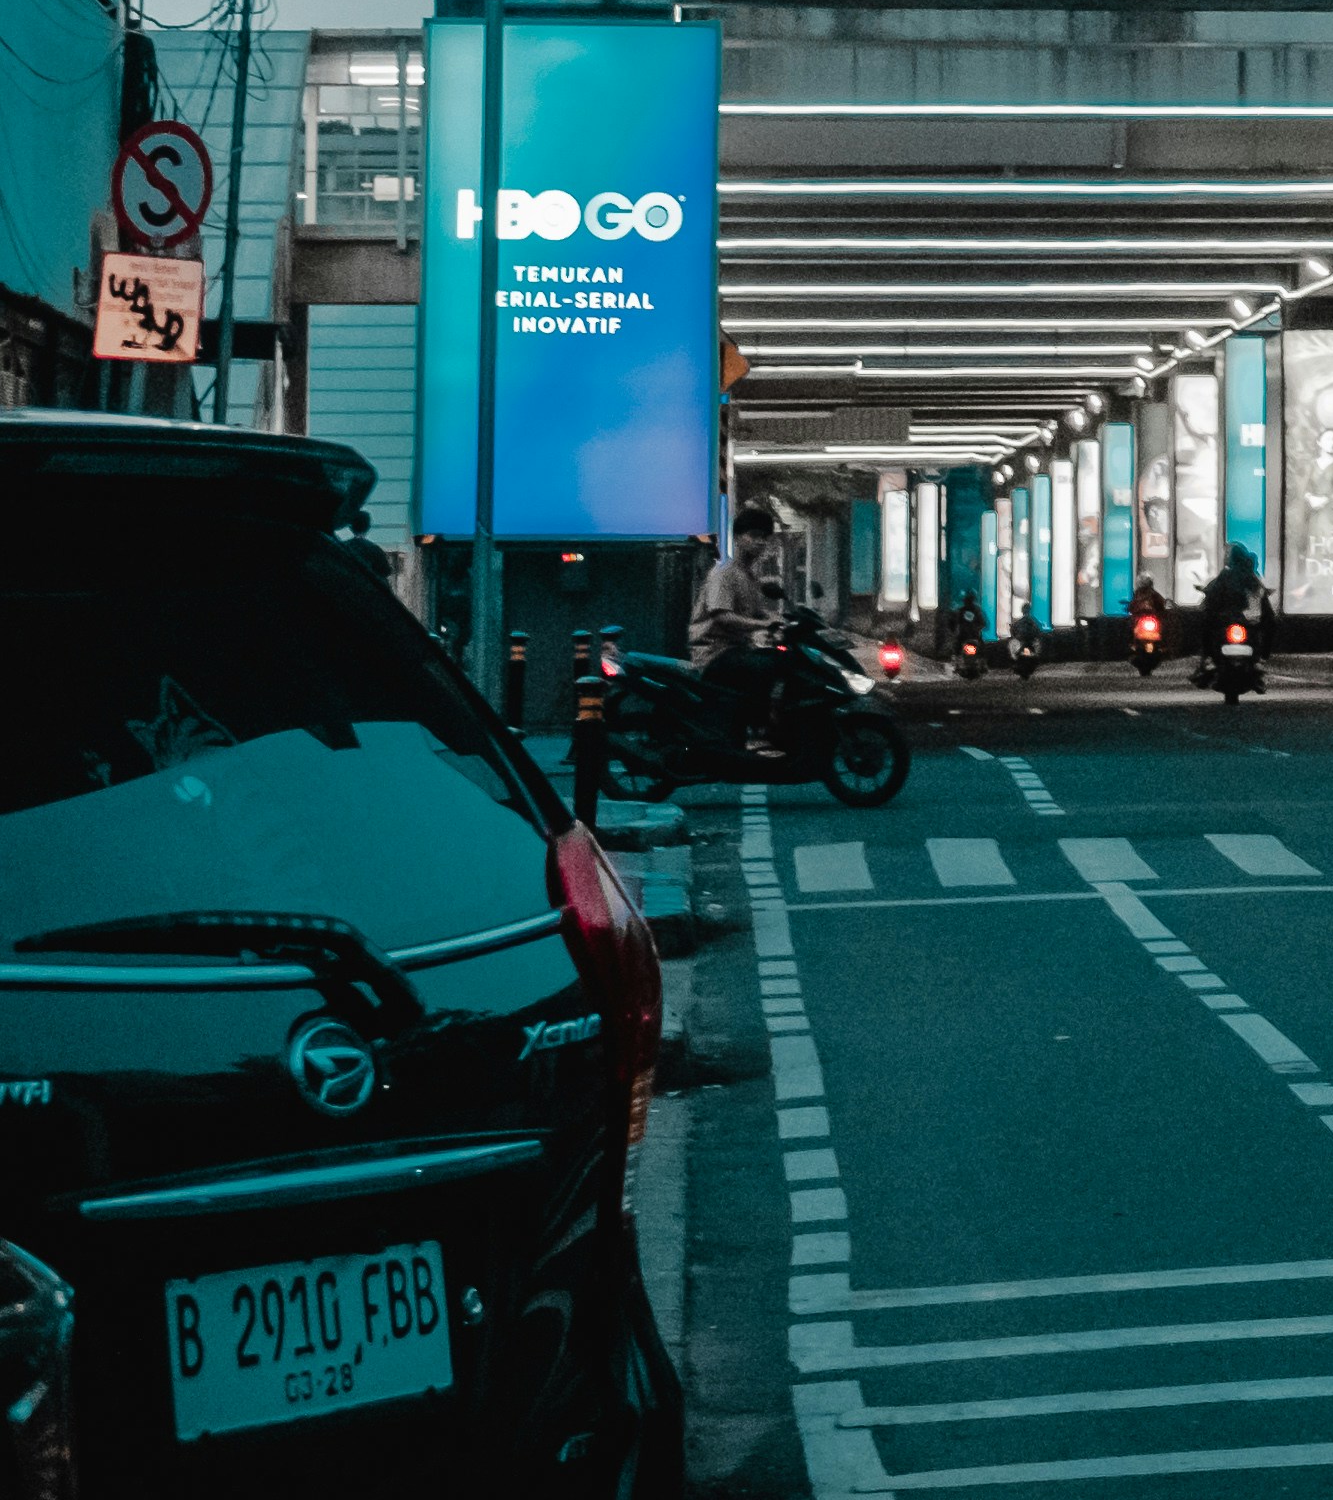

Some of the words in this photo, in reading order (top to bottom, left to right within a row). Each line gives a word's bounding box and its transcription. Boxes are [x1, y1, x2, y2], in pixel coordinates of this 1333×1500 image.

[138, 145, 182, 227] S
[512, 264, 624, 284] TEMUKAN
[494, 291, 655, 310] ERIAL-SERIAL
[512, 316, 622, 334] INOVATIF
[176, 1294, 204, 1378] B
[232, 1270, 342, 1369] 2910
[362, 1255, 441, 1344] FBB
